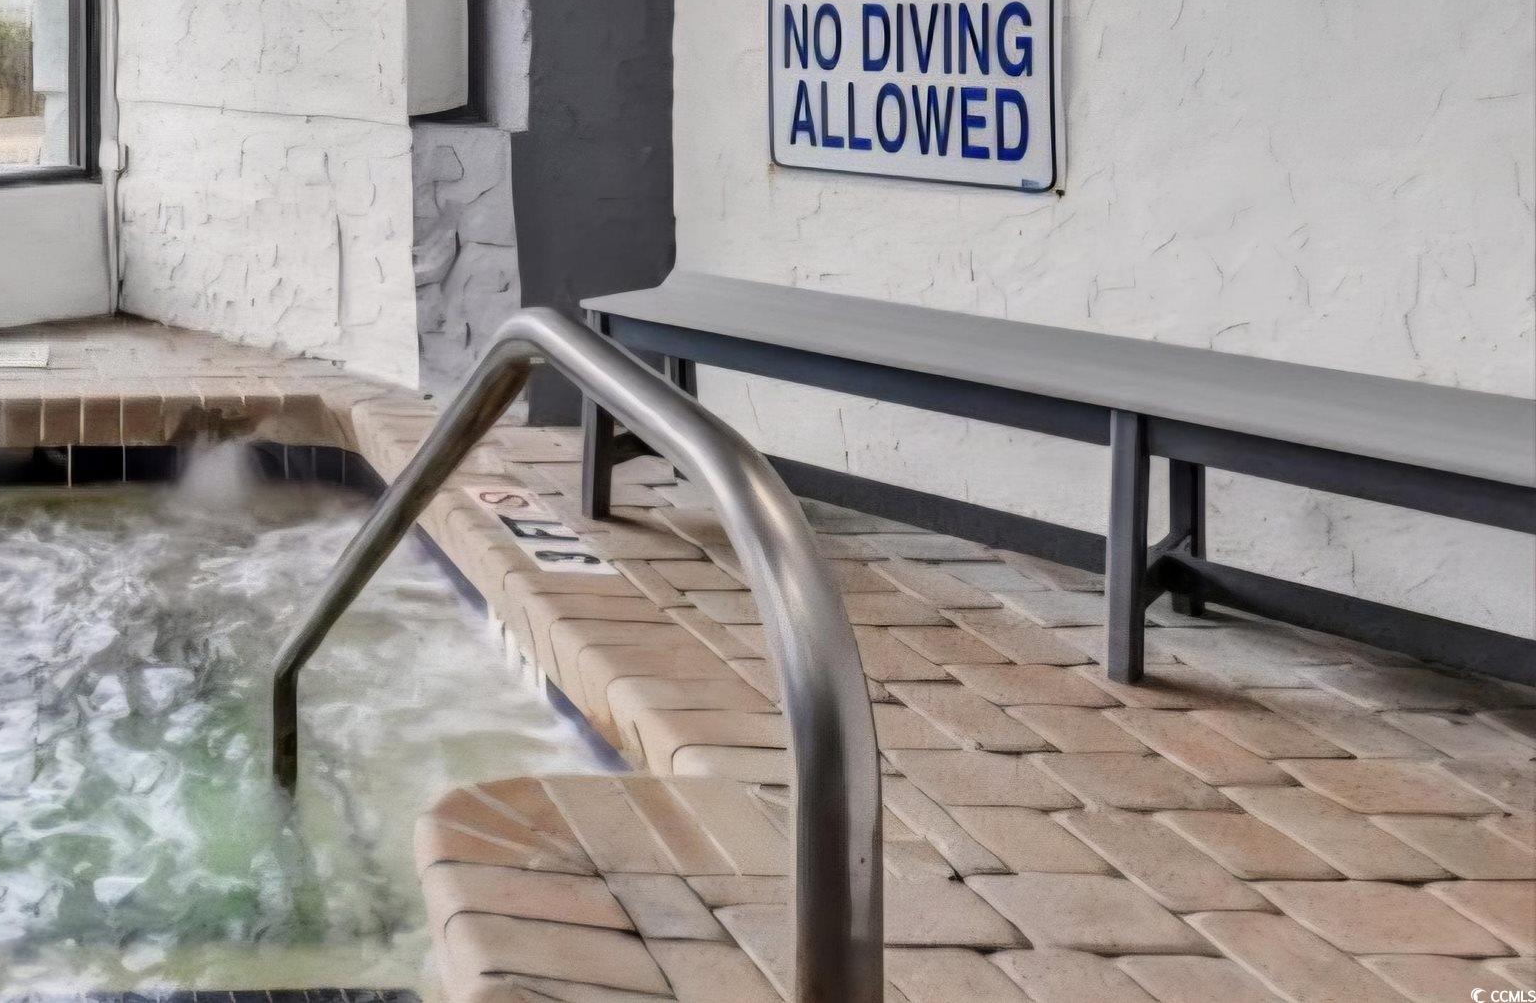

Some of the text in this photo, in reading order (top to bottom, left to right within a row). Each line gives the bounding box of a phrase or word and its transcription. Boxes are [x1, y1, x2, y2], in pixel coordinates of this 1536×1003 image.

[784, 1, 1032, 77] NO DIVING
[790, 80, 1030, 161] ALLOWED
